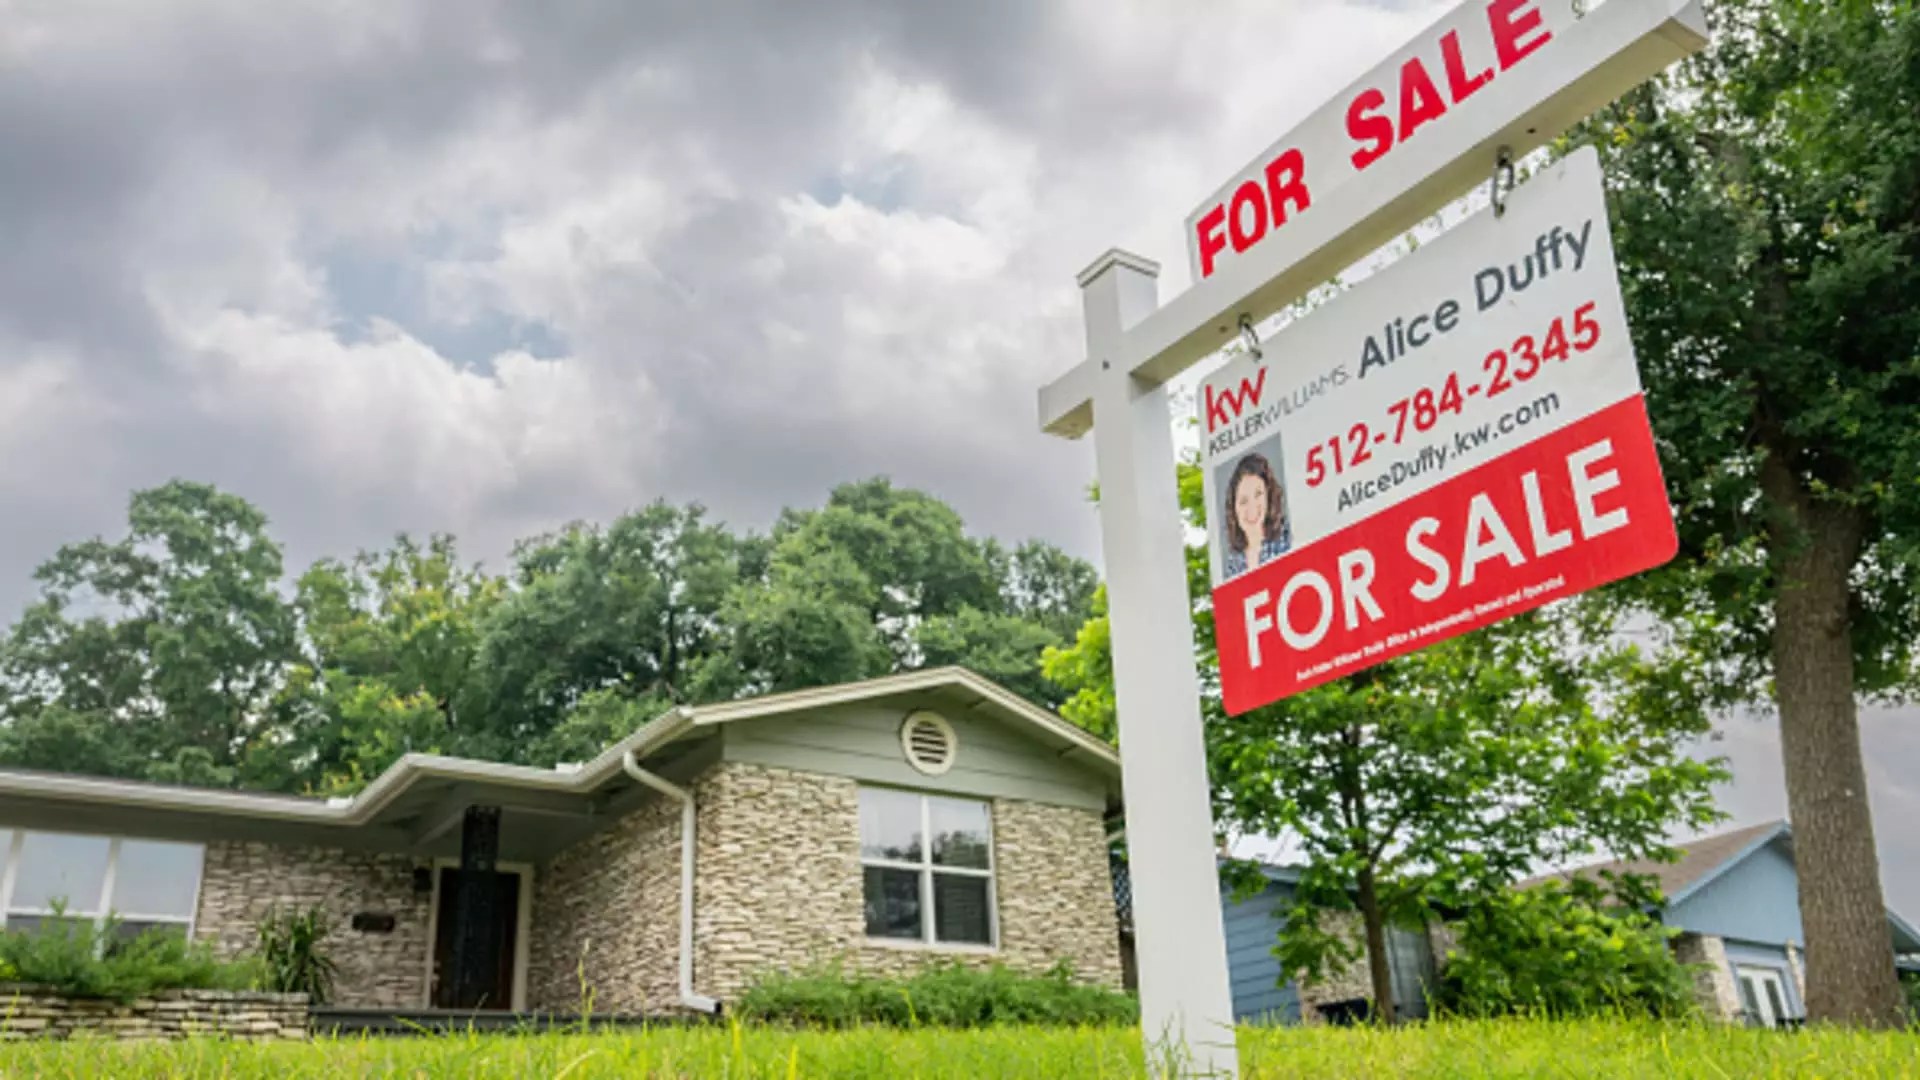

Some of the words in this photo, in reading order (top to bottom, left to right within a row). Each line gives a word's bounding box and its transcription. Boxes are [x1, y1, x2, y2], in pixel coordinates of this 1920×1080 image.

[1196, 148, 1311, 278] FOR
[1345, 0, 1552, 170] SALE
[1357, 300, 1460, 378] Alice
[1474, 219, 1592, 312] Duffy
[1205, 366, 1268, 433] kw
[1305, 301, 1600, 488] 512-784-2345
[1338, 392, 1560, 512] AliceDuffy.kw.com
[1243, 548, 1385, 670] FOR
[1405, 438, 1630, 602] SALE
